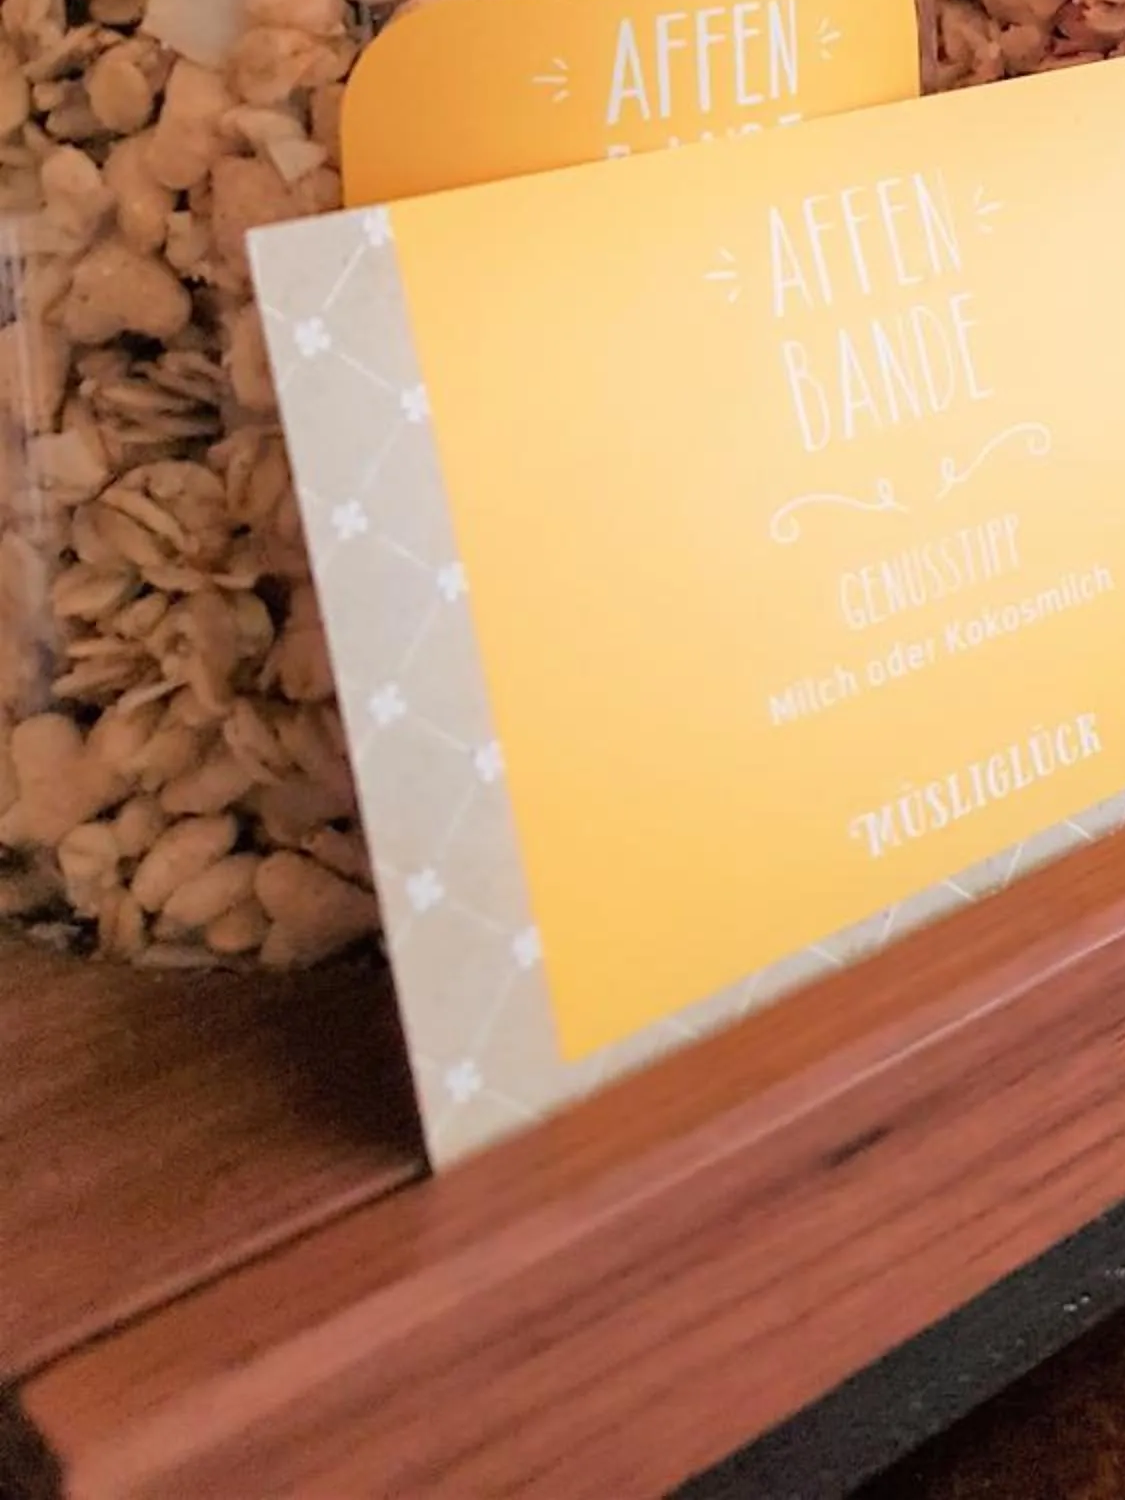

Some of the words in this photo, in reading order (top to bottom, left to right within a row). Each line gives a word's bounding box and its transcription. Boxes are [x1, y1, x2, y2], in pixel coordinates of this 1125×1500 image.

[768, 169, 963, 318] AFFEN
[780, 290, 994, 453] BANDE
[768, 663, 861, 726] Milch
[867, 635, 938, 687] oder
[943, 563, 1115, 654] Kokosmilch
[837, 511, 1021, 631] GENUSSTIPP
[849, 711, 1103, 859] MÜSLIGLÜCK
